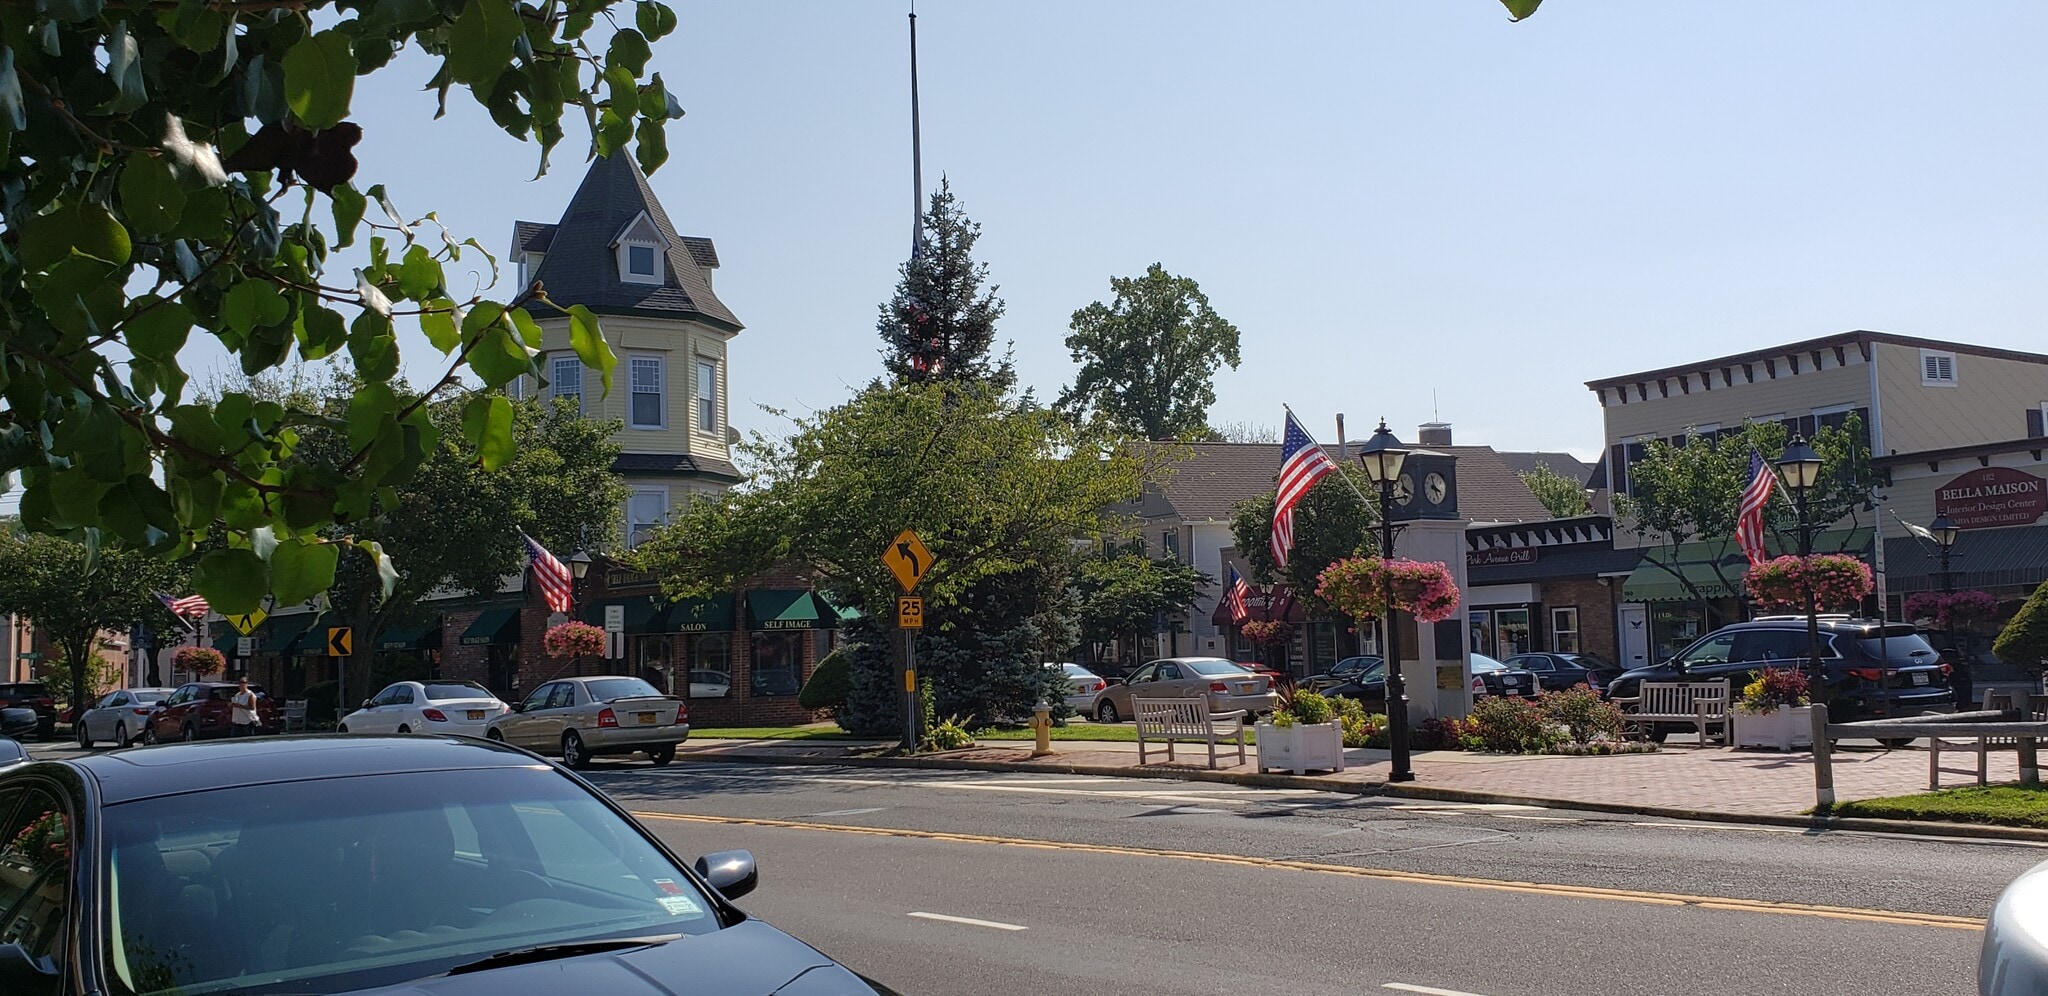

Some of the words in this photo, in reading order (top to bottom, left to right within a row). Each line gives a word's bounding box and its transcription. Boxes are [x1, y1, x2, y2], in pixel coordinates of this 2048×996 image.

[1983, 473, 1995, 481] 182
[1942, 487, 1982, 500] BELLA
[1985, 481, 2039, 497] MAISON
[1947, 505, 1976, 514] Interior
[1978, 502, 2006, 512] Design
[2007, 499, 2037, 509] Center
[1971, 515, 1998, 524] DESIGN
[1999, 512, 2030, 522] LIMITED
[1510, 549, 1530, 562] Grill
[901, 600, 921, 616] 25
[680, 622, 707, 632] SALON
[764, 620, 784, 629] SELF
[785, 620, 812, 629] IMAGE
[903, 617, 919, 625] MPH
